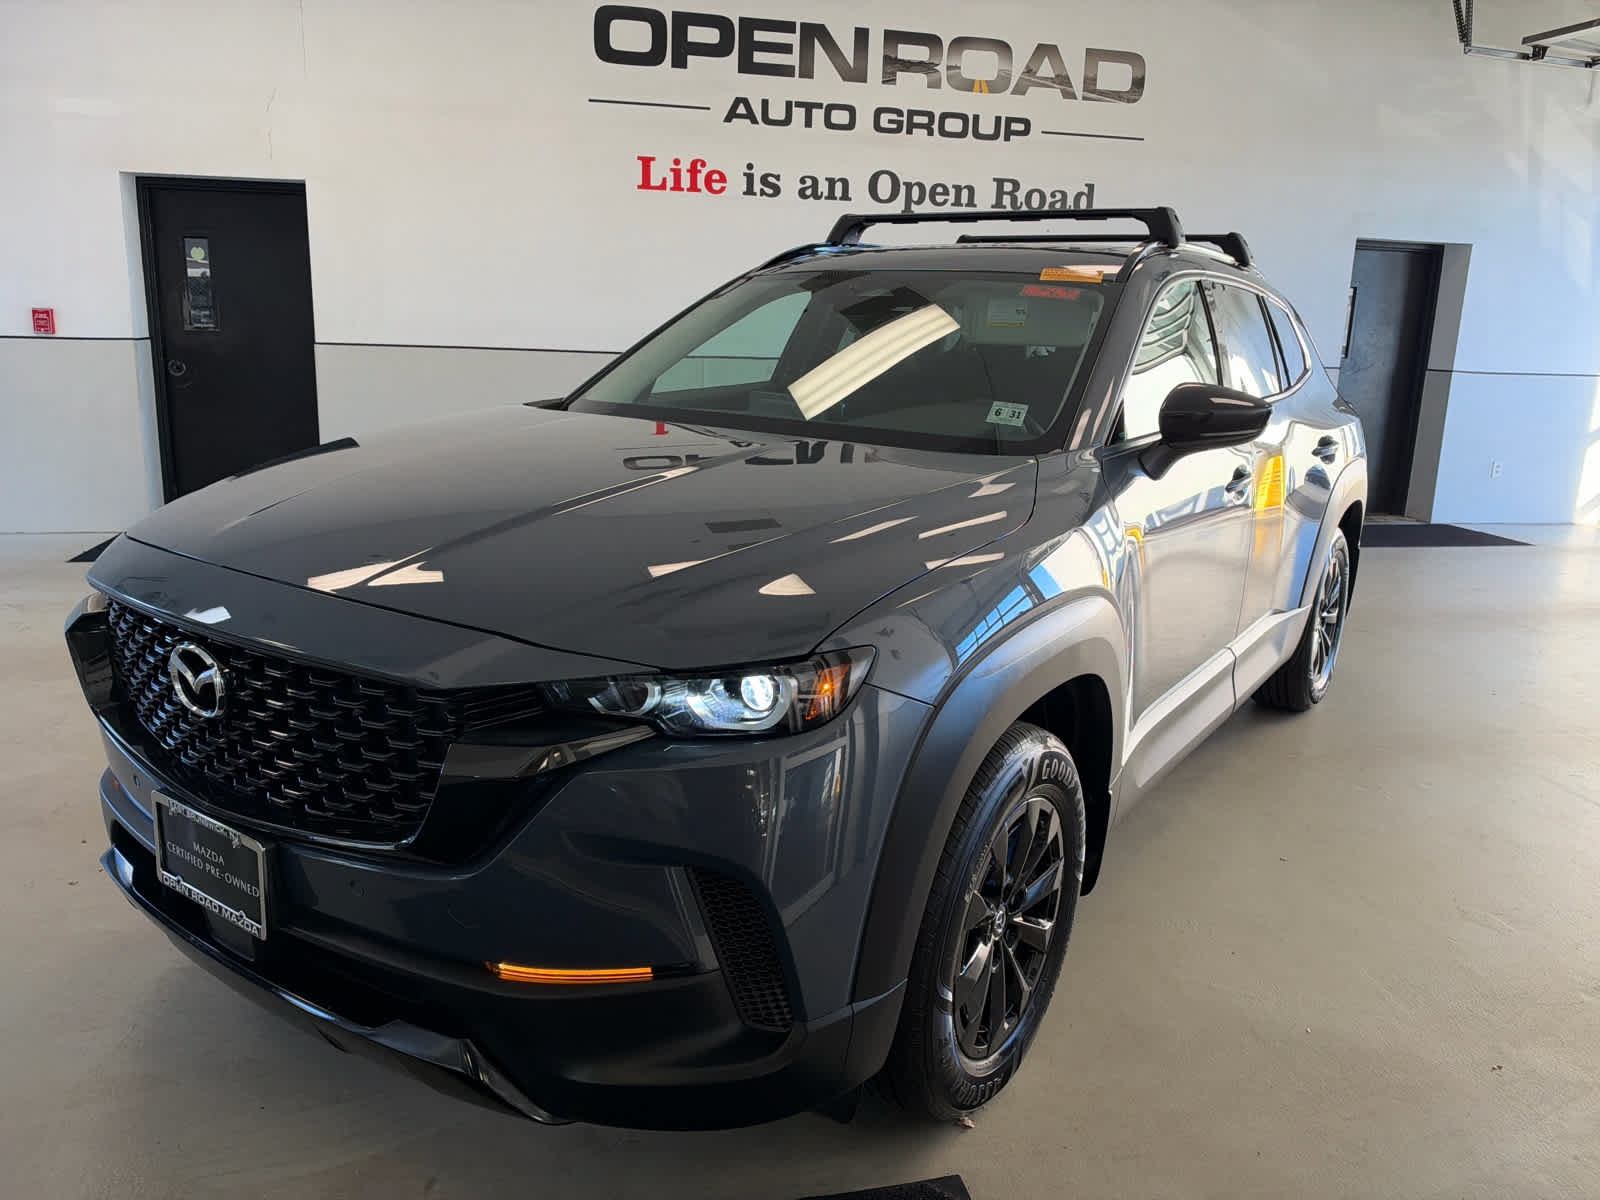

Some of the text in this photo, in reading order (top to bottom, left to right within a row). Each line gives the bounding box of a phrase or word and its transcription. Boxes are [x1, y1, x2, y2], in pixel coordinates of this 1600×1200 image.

[594, 5, 1146, 105] OPEN ROAD
[723, 96, 1032, 142] AUTO GROUP
[636, 156, 1095, 215] Life is an Open Road
[994, 407, 1021, 420] 6 31
[166, 841, 260, 898] CERTIFIED PRE-OWNED
[193, 841, 225, 866] MAZDA
[163, 876, 259, 937] OPEN ROAD MAZDA
